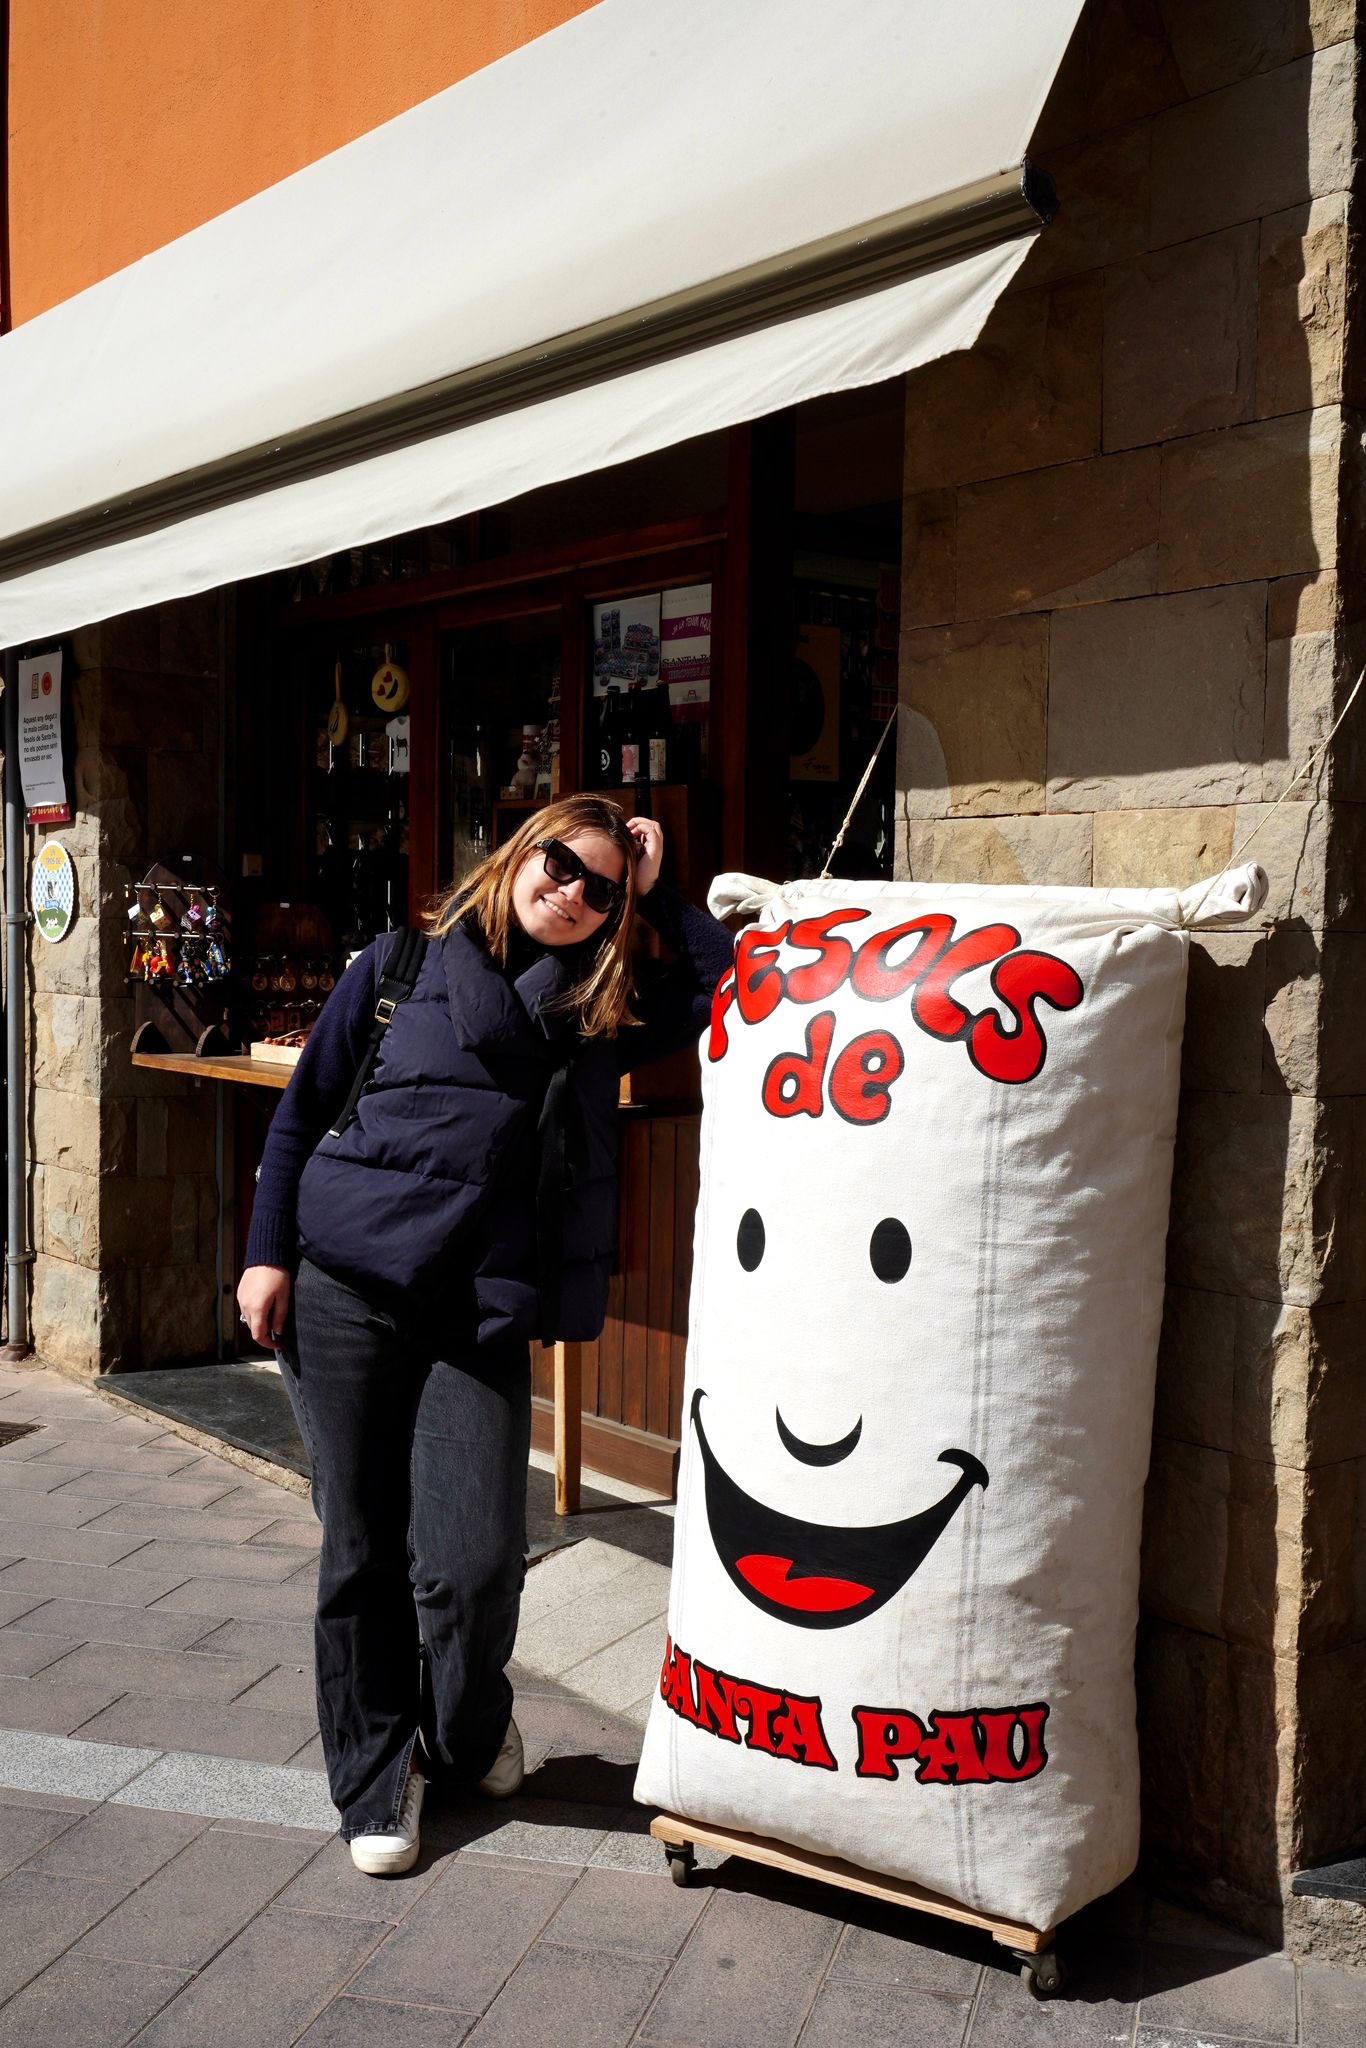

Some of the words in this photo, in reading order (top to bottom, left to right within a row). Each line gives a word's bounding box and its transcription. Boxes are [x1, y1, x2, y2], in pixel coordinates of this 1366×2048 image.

[662, 655, 698, 665] SANTA
[41, 733, 51, 741] Santa
[761, 1009, 906, 1127] de
[851, 1700, 1051, 1786] PAU
